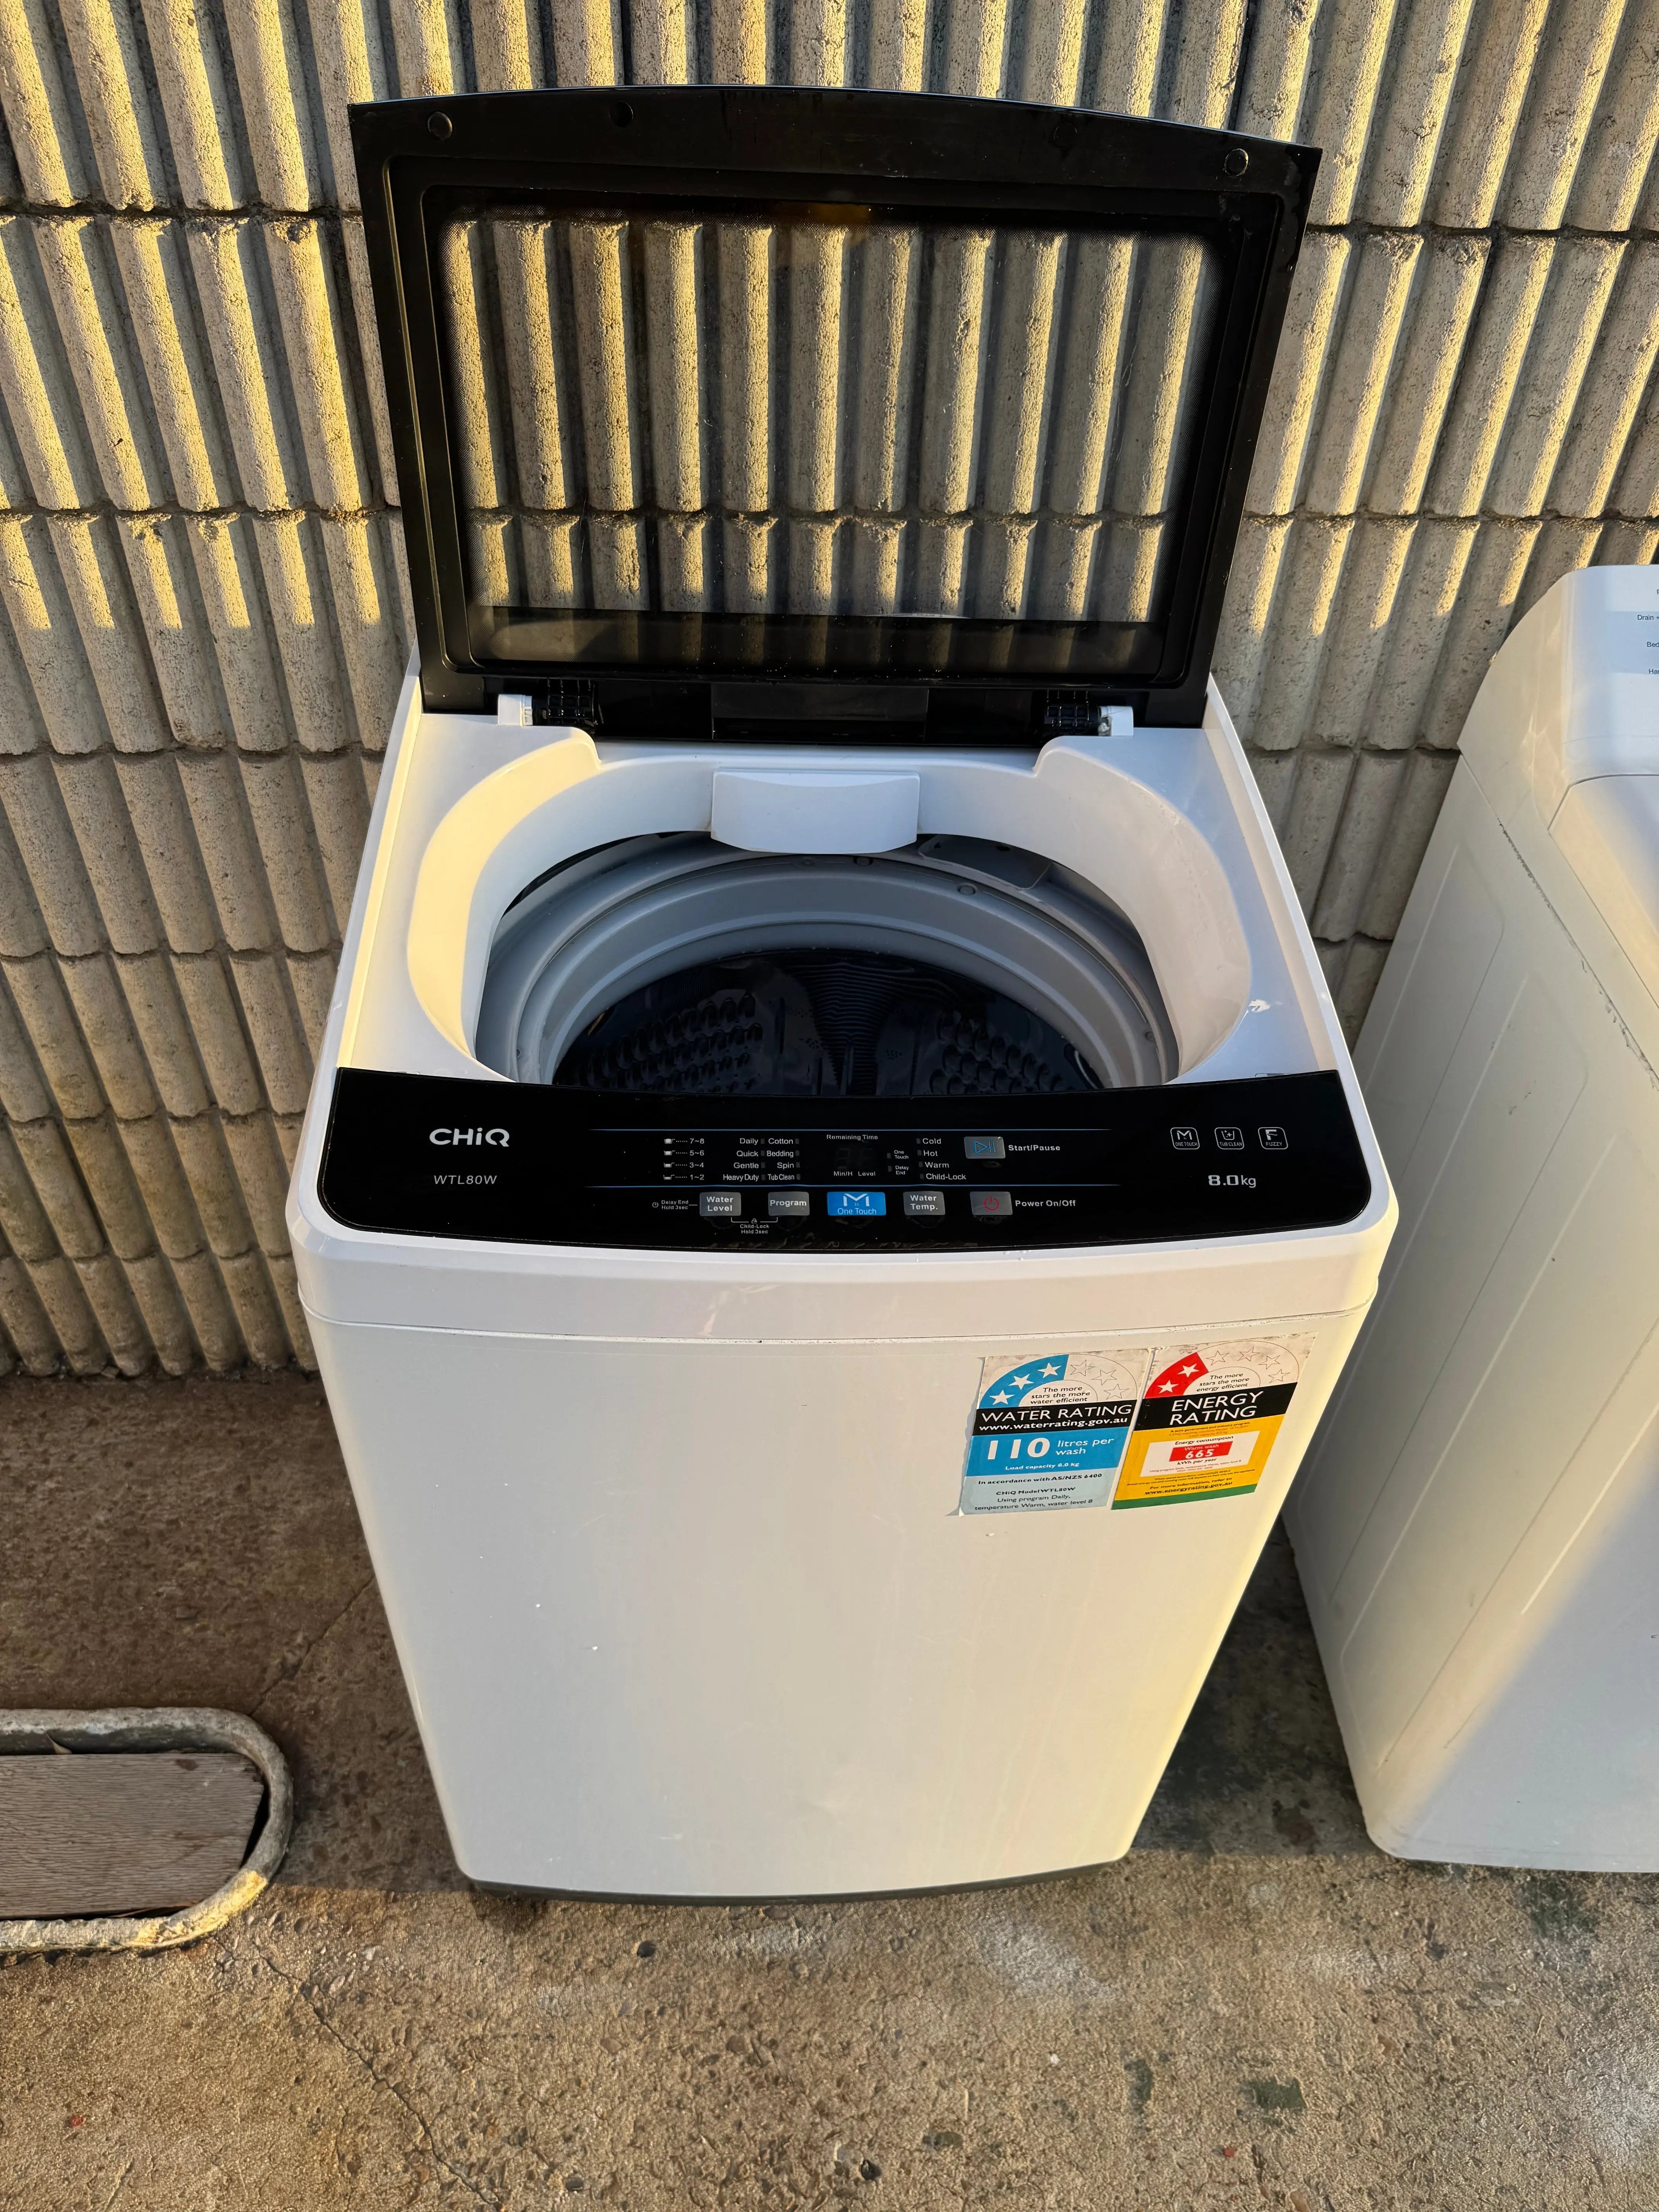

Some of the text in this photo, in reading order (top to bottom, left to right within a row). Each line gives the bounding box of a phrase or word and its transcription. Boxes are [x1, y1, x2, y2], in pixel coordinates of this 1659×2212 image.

[429, 1127, 510, 1147] CHiQ
[434, 1175, 497, 1184] WTL80W
[1171, 1391, 1264, 1412] ENERGY
[982, 1405, 1132, 1422] WATER RATING
[1169, 1406, 1257, 1425] RATING
[979, 1417, 1127, 1431] www.waterrating.gov.au
[988, 1437, 1050, 1460] 110
[1092, 1438, 1115, 1447] per
[1056, 1447, 1086, 1456] wash
[1185, 1449, 1214, 1459] 665
[1145, 1481, 1233, 1495] www.energyrating.gov.au
